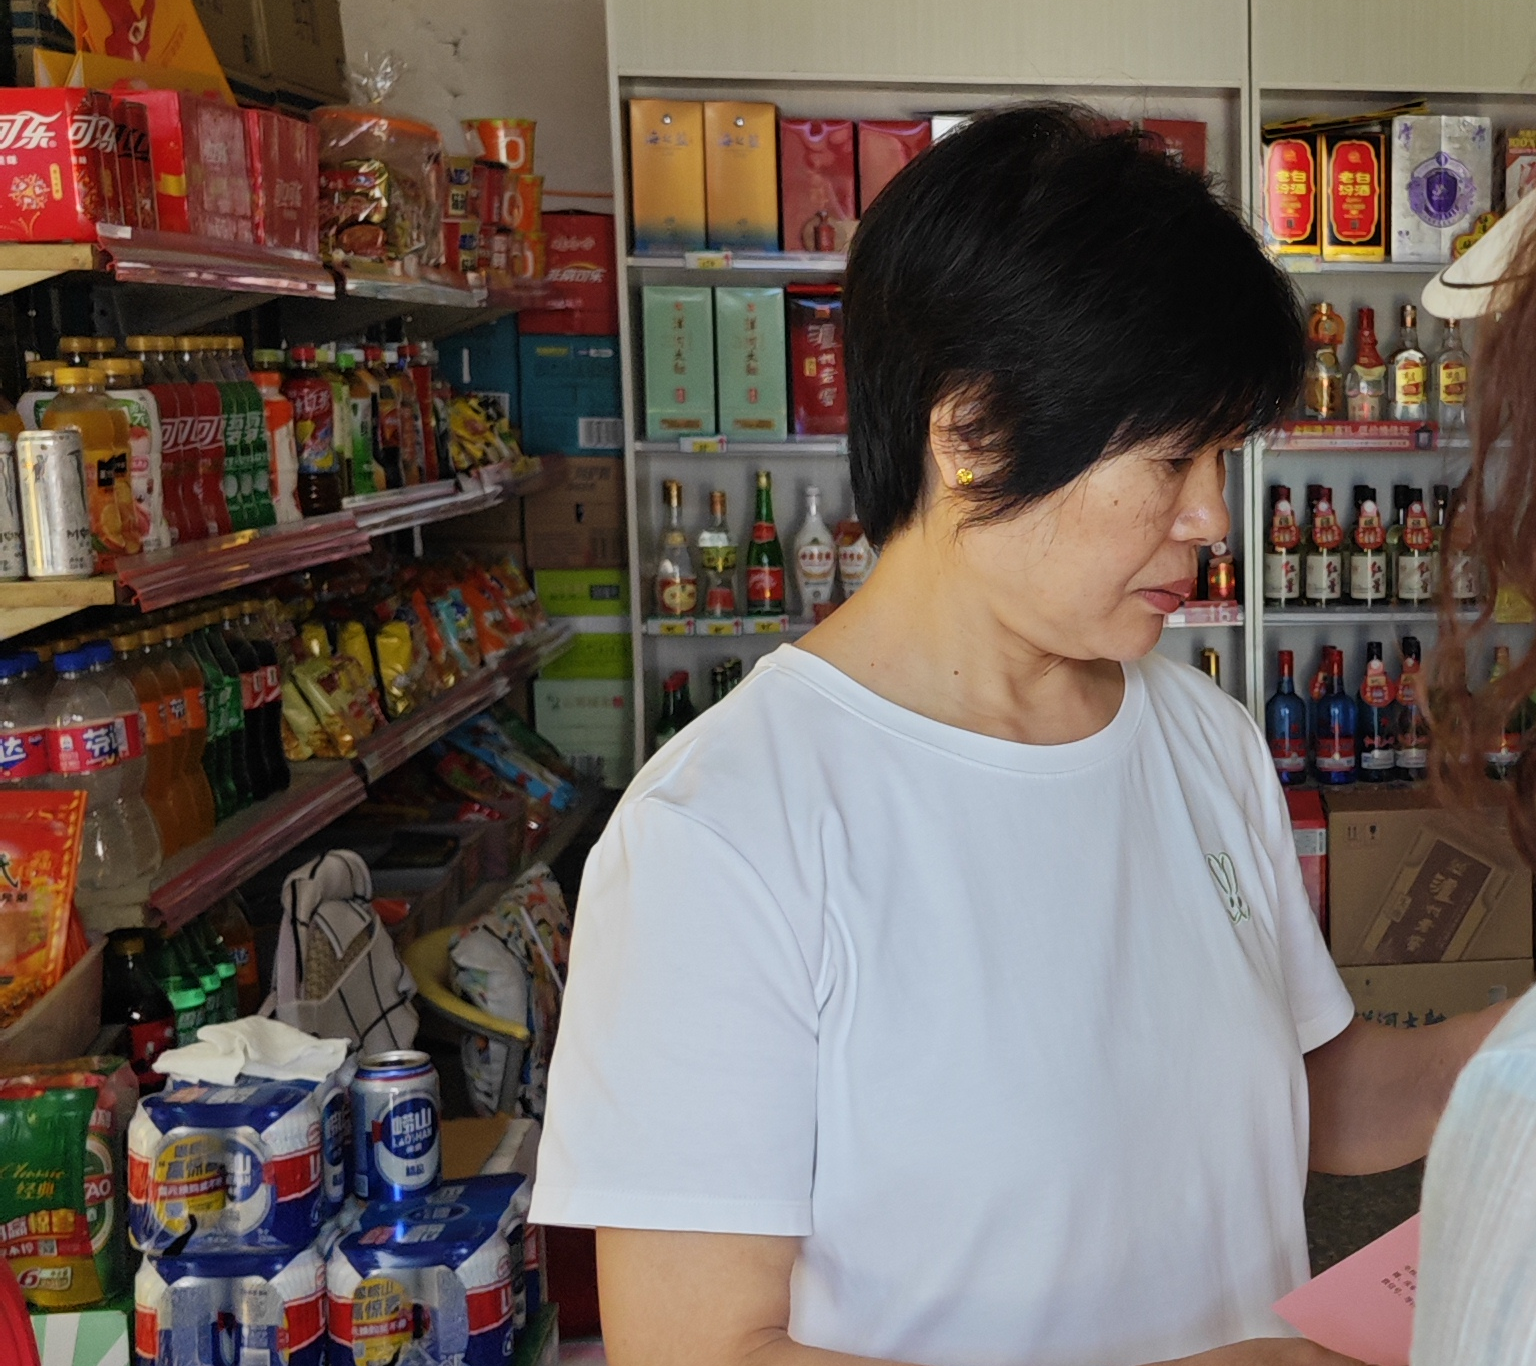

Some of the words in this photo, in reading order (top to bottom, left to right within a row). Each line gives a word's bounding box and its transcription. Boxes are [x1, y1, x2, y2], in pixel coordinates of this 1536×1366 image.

[1276, 183, 1306, 195] 汾酒
[1338, 184, 1371, 196] 汾酒
[392, 1107, 432, 1135] 崂山
